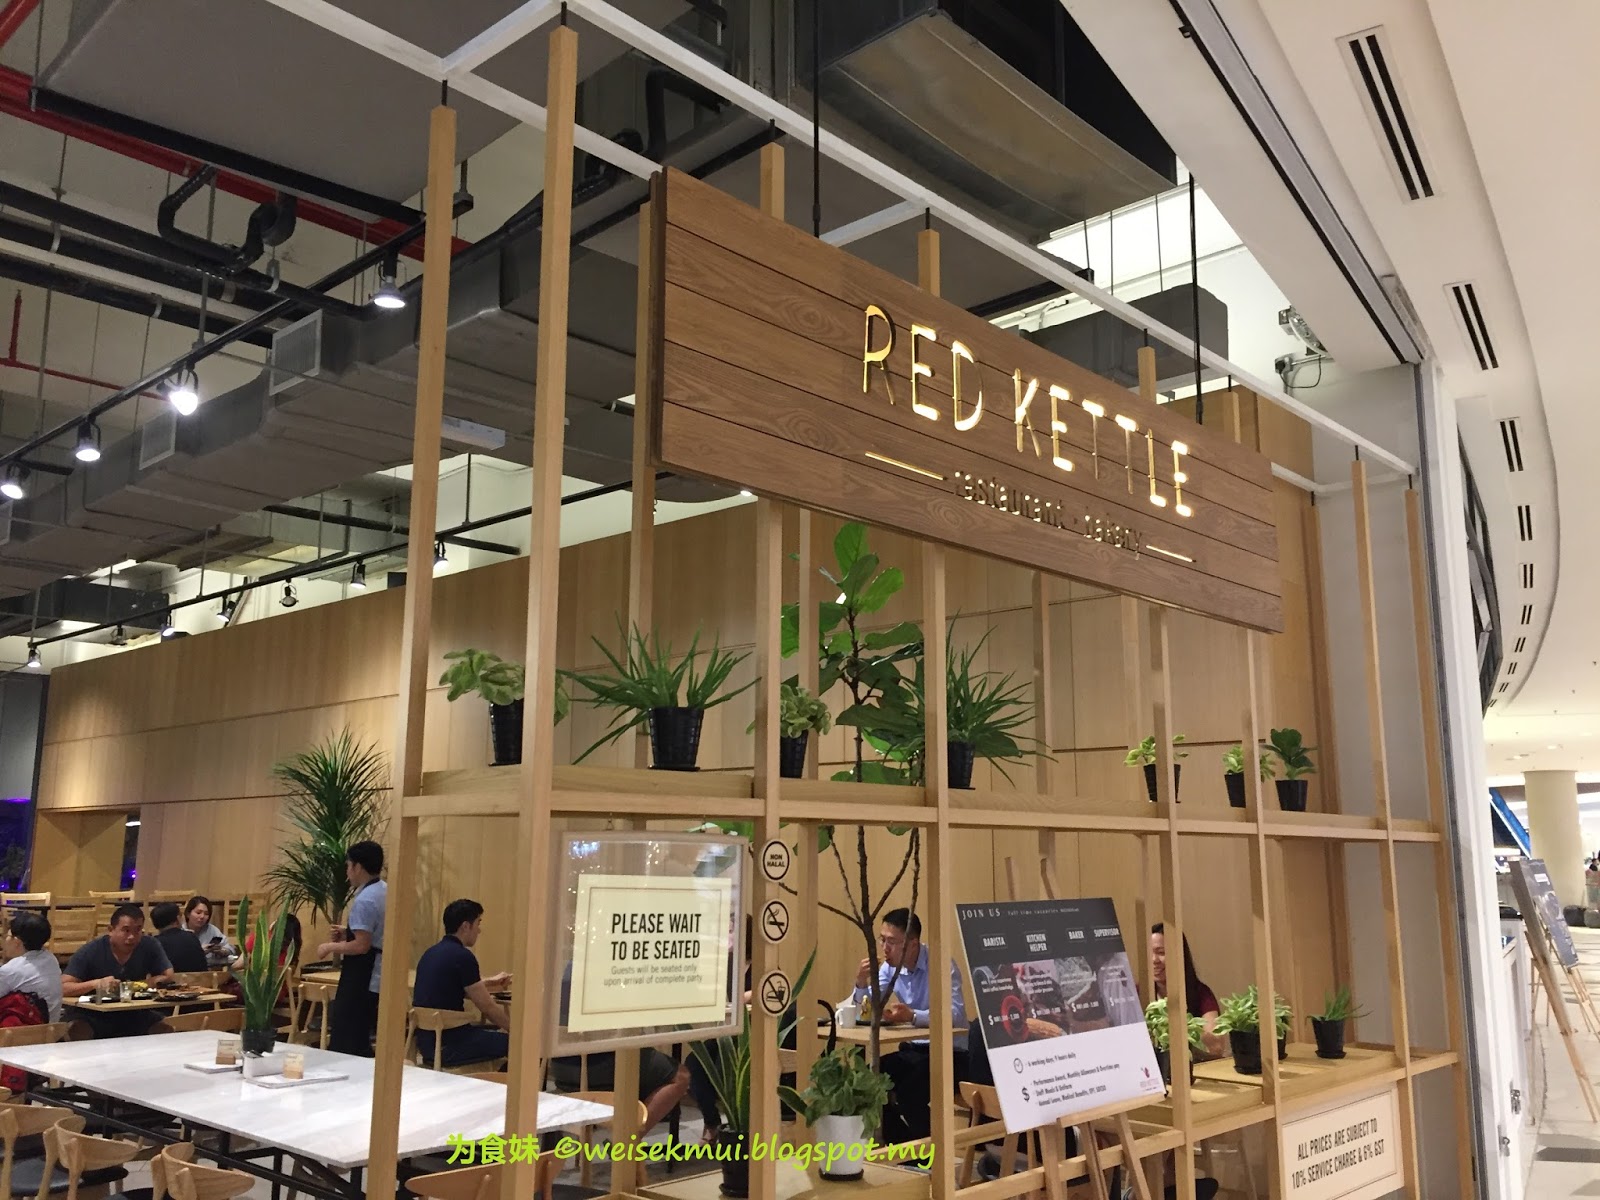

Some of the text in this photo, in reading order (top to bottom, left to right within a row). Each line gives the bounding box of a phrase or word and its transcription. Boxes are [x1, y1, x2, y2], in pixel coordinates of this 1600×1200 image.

[862, 304, 1194, 517] RED KETTLE
[962, 908, 1001, 920] JOIN US
[611, 913, 702, 934] PLEASE WAIT
[1026, 933, 1046, 943] KITCHEN
[1068, 930, 1084, 939] BAKER
[983, 937, 1006, 947] BARISTA
[1029, 942, 1048, 952] HELPER
[611, 940, 700, 960] TO BE SEATED
[611, 963, 697, 975] Guests will be seated only
[603, 974, 703, 987] upon arrival of complete party
[1297, 1117, 1378, 1161] ALL PRICES ARE SUBJECT TO
[1291, 1138, 1385, 1190] 10% SERVICE CHARGE & 6% GST
